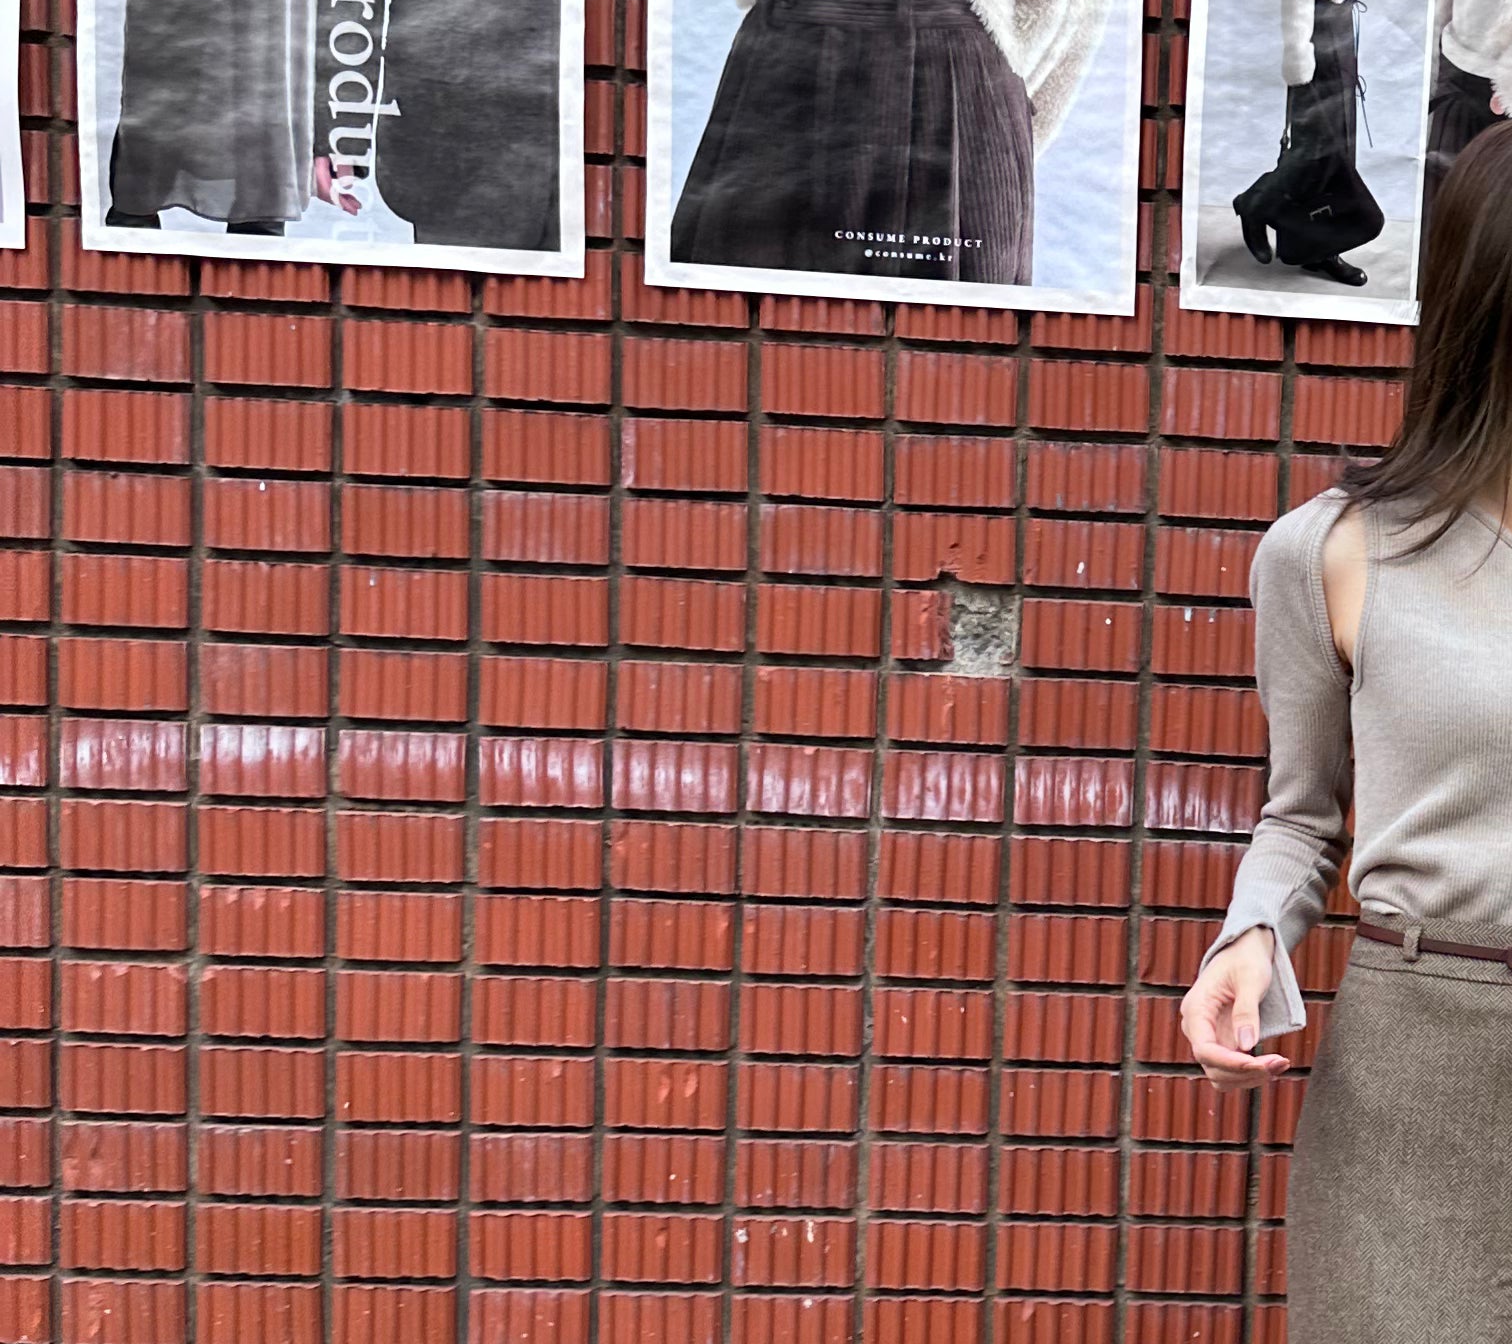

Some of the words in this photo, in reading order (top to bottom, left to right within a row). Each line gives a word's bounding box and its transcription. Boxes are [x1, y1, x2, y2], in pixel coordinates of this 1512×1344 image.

[834, 229, 906, 244] CONSUME
[913, 235, 983, 249] PRODUCT
[864, 248, 953, 263] @consume.kr
